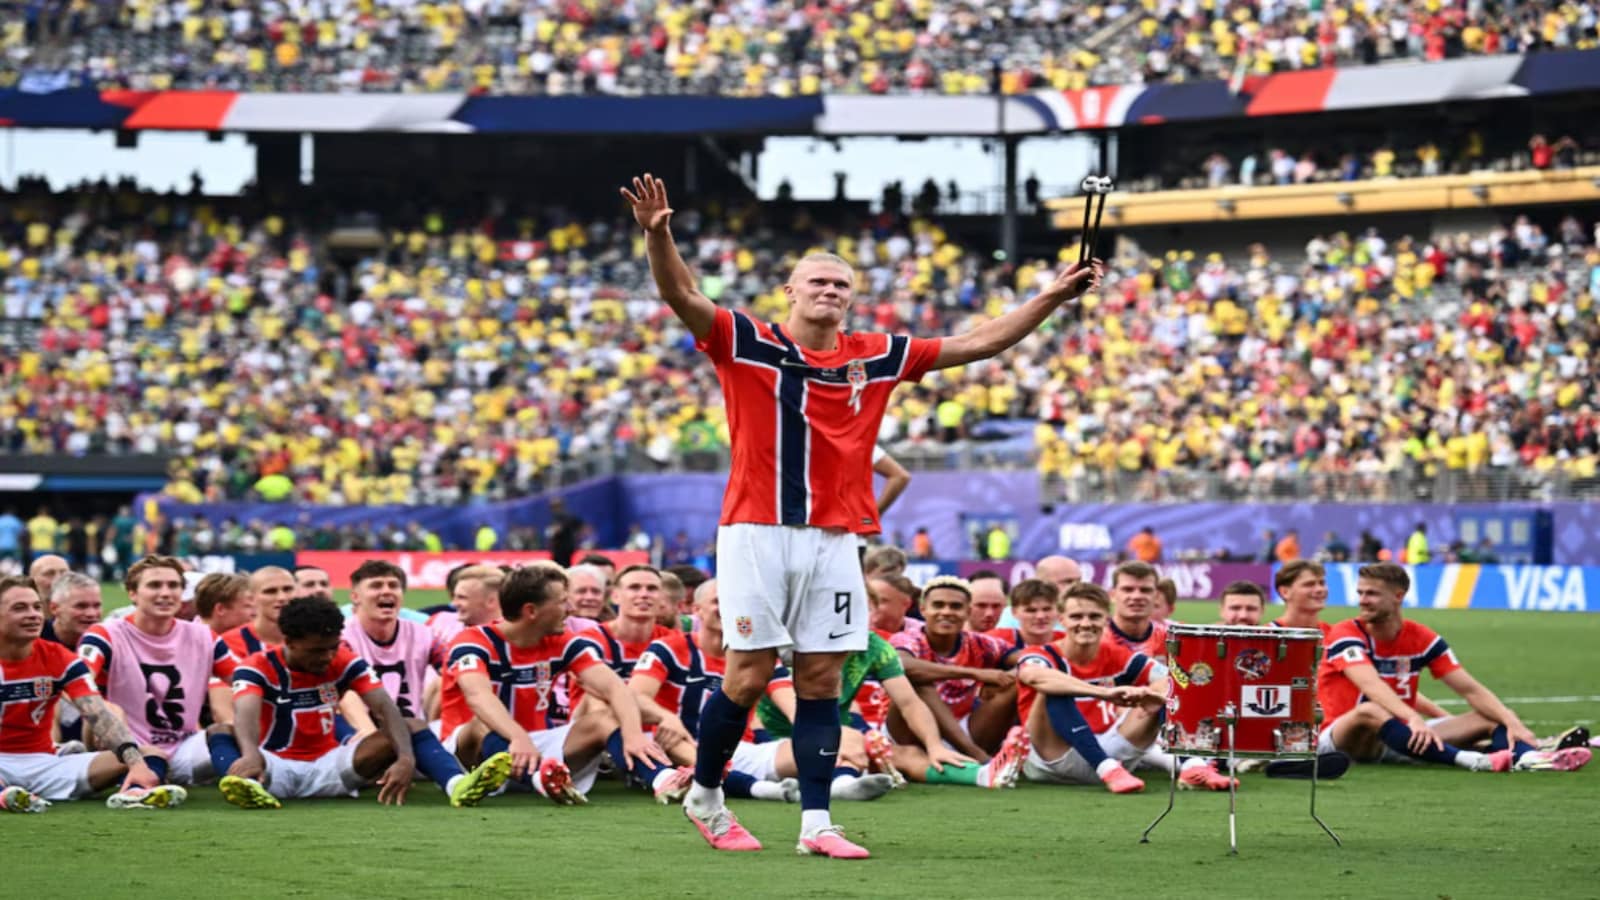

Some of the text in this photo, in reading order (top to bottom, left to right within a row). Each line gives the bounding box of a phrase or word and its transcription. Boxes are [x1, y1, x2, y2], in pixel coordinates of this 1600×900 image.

[1059, 523, 1113, 550] FIFA
[1499, 565, 1587, 610] VISA
[834, 592, 851, 625] 9
[535, 685, 550, 712] 8
[1396, 675, 1411, 700] 3
